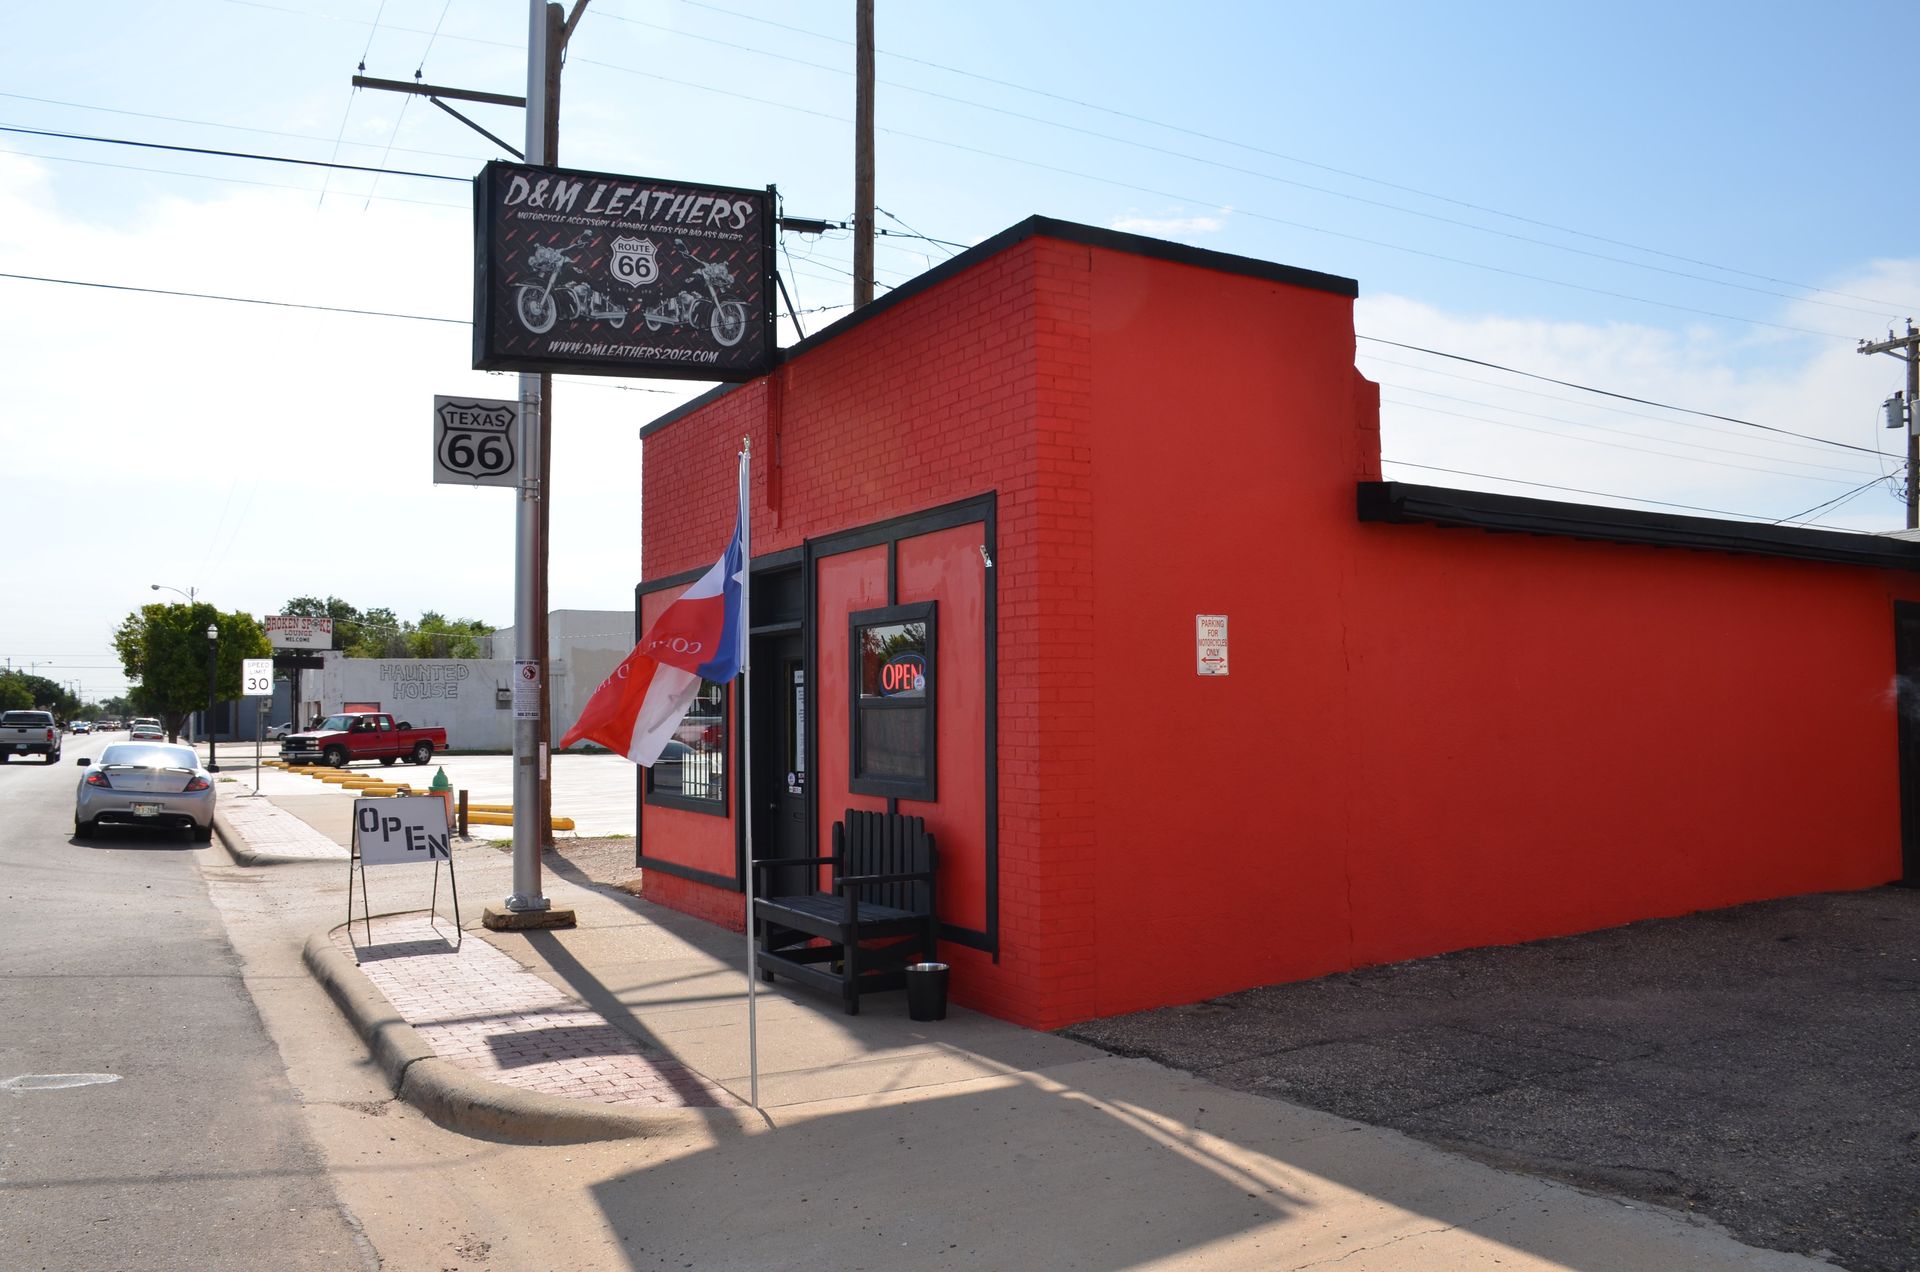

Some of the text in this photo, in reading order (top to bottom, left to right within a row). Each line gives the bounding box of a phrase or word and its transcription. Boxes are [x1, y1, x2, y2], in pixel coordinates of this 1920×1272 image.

[503, 175, 752, 229] D&M LEATHERS
[517, 212, 566, 222] MOTORCYCLE
[567, 216, 609, 227] ACCESSORY
[649, 225, 673, 233] NEEDS
[673, 227, 688, 236] FOR
[688, 228, 702, 237] BAD
[702, 231, 718, 239] ASS
[618, 243, 651, 253] ROUTE
[618, 255, 651, 278] 66
[548, 341, 719, 363] WWW.DMLEATHERS2012.COM
[446, 411, 506, 427] TEXAS
[447, 434, 504, 470] 66
[266, 617, 300, 632] BROKEN
[1201, 620, 1224, 628] PARKING
[284, 629, 313, 637] LOUNGE
[1206, 648, 1219, 656] ONLY
[380, 664, 470, 681] HAUNTED
[882, 663, 922, 690] OPEN
[247, 677, 269, 691] 30
[393, 682, 458, 700] HOUSE
[359, 807, 449, 859] OPEN
